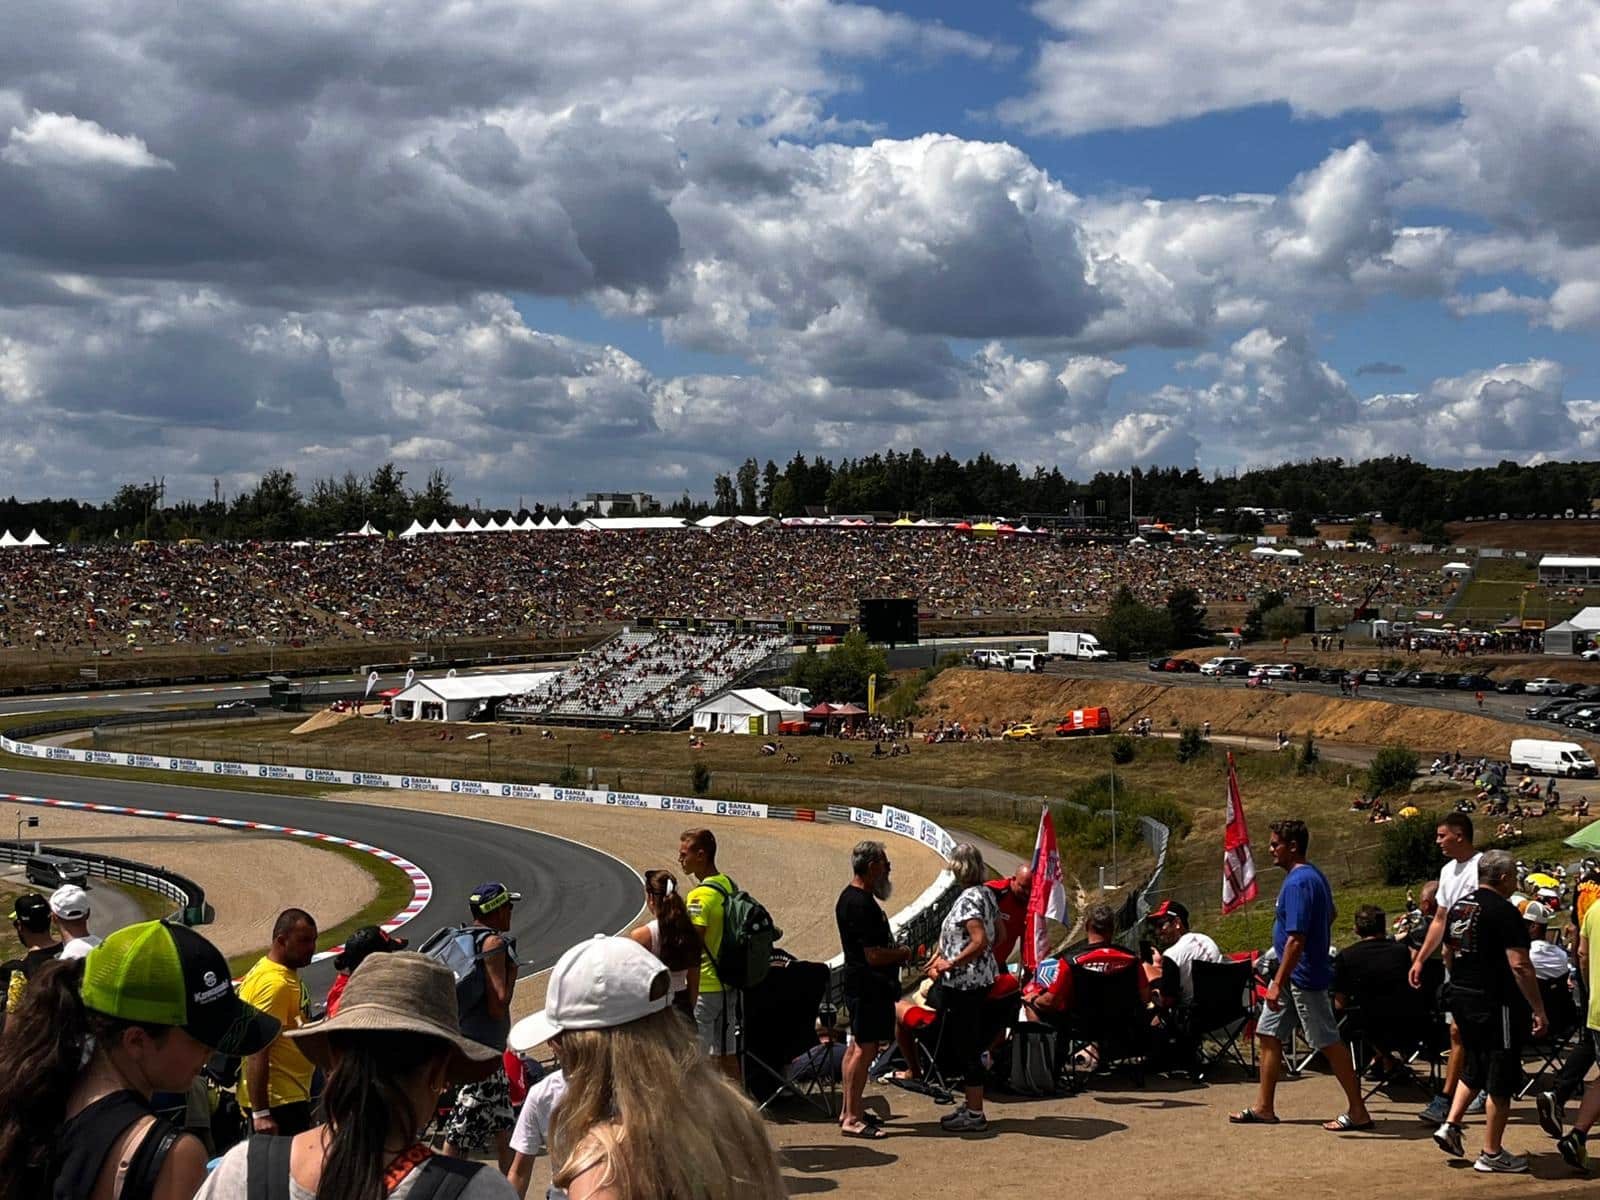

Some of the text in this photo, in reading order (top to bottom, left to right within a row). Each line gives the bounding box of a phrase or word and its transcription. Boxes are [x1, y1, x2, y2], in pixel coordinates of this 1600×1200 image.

[617, 799, 648, 807] CREDITAS
[672, 797, 695, 805] BANKA
[672, 803, 704, 812] CREDITAS
[728, 802, 751, 810] BANKA
[728, 808, 761, 817] CREDITAS
